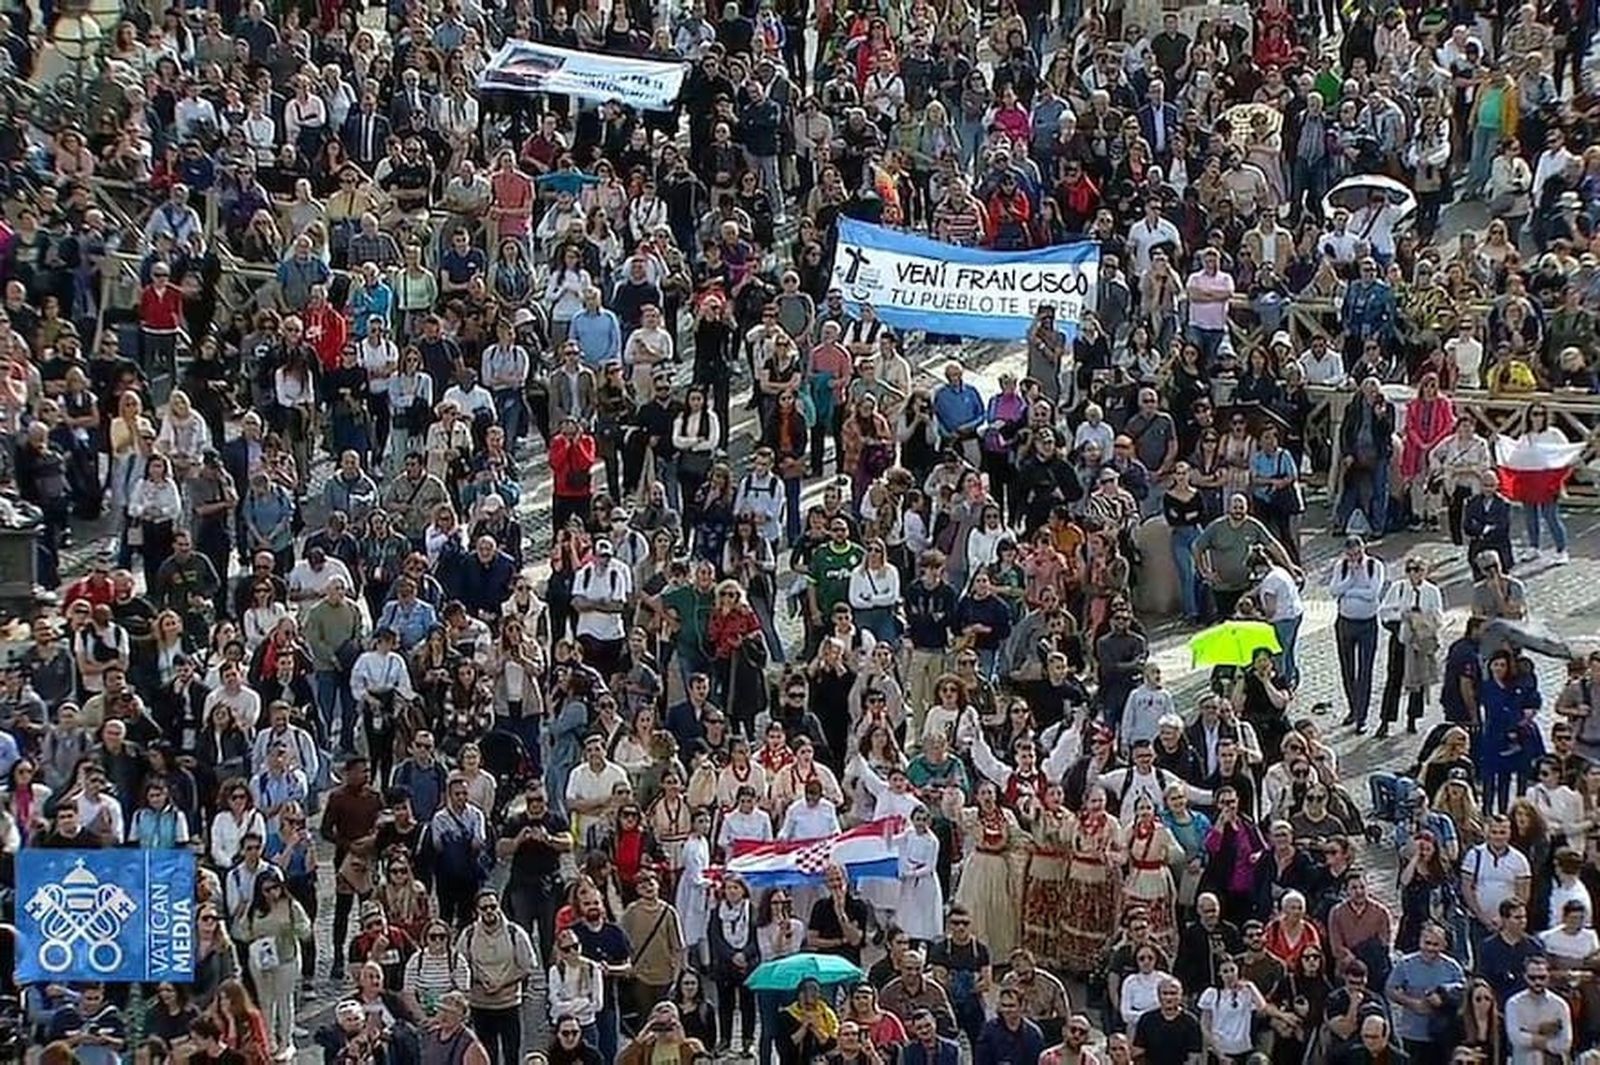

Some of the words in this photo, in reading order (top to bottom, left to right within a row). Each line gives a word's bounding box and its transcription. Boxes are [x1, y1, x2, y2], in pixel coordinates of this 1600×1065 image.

[896, 260, 949, 289] VENÍ
[955, 268, 1089, 297] FRANCISCO
[891, 287, 916, 307] TU
[920, 291, 995, 314] PUEBLO
[999, 297, 1019, 314] TE
[1028, 298, 1086, 319] EPER
